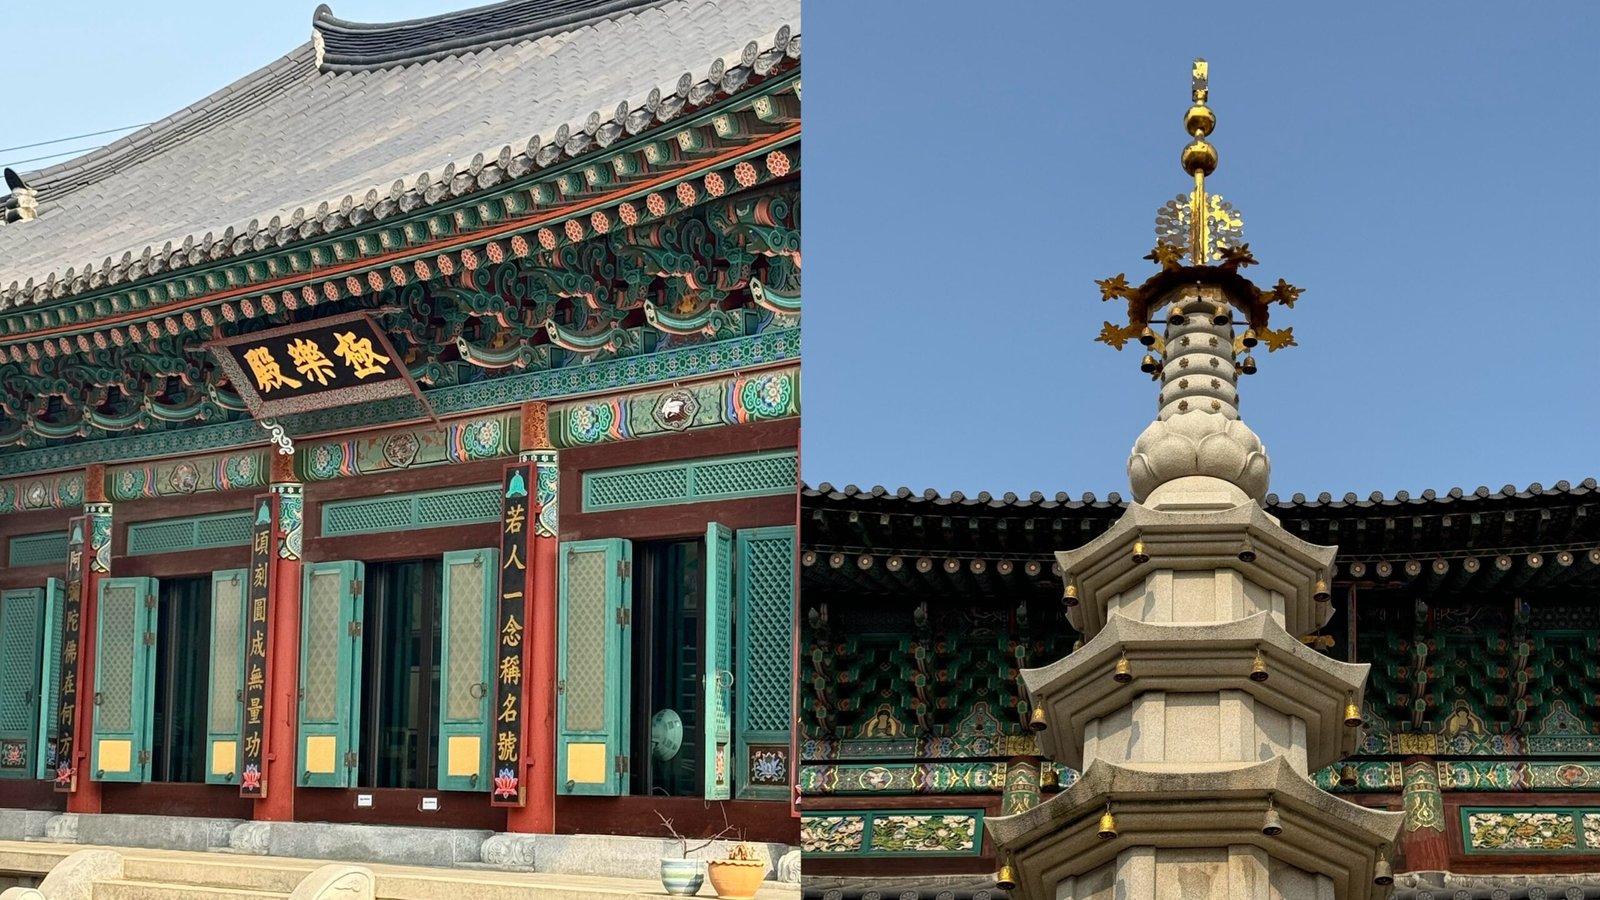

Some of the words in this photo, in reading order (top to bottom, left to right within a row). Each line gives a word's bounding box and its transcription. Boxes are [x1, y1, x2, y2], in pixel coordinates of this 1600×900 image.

[245, 530, 269, 757] 頃刻圓成無量功
[497, 504, 526, 762] 若人一念稱名號
